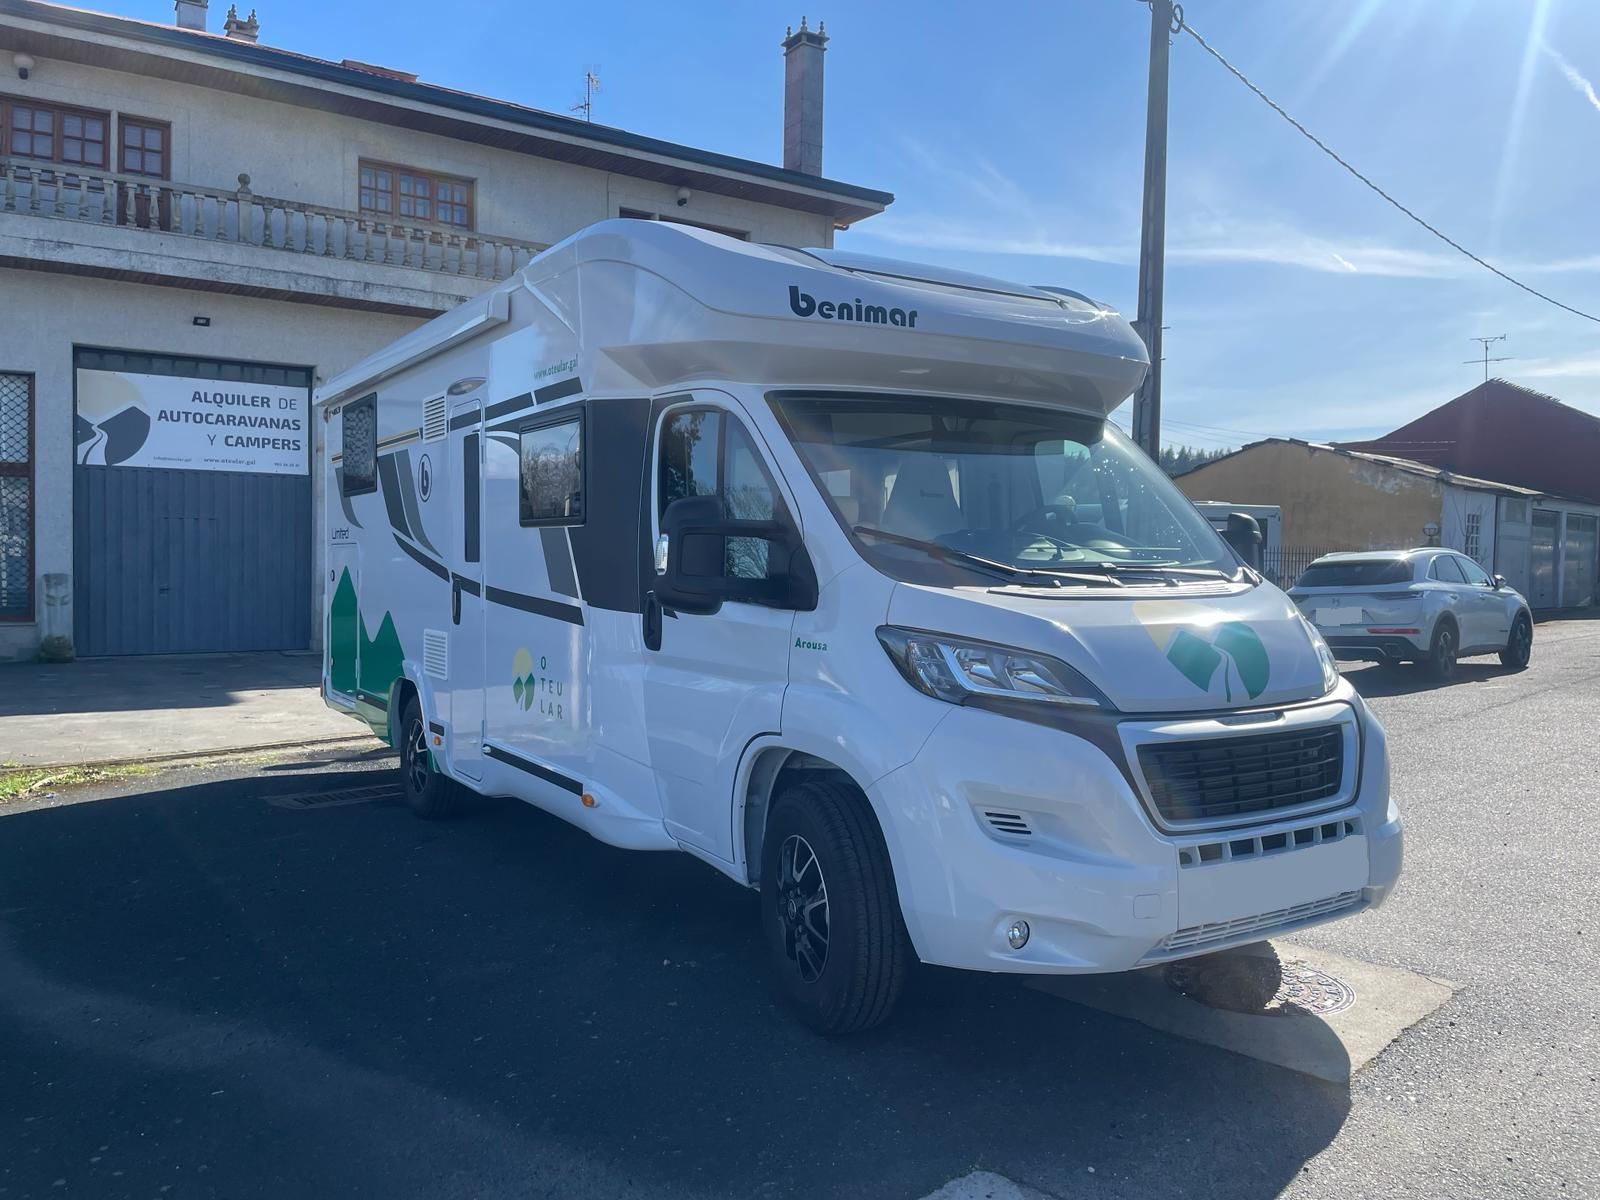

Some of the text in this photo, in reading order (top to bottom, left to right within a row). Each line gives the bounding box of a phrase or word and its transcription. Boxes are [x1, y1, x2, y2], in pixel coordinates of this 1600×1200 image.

[788, 285, 918, 328] benimar
[191, 391, 297, 411] ALQUILER DE
[157, 409, 301, 431] AUTOCARAVANAS
[207, 434, 301, 451] Y CAMPERS
[794, 636, 828, 651] Arousa
[540, 655, 547, 670] O
[540, 677, 563, 697] TEU
[540, 699, 563, 720] LAR
